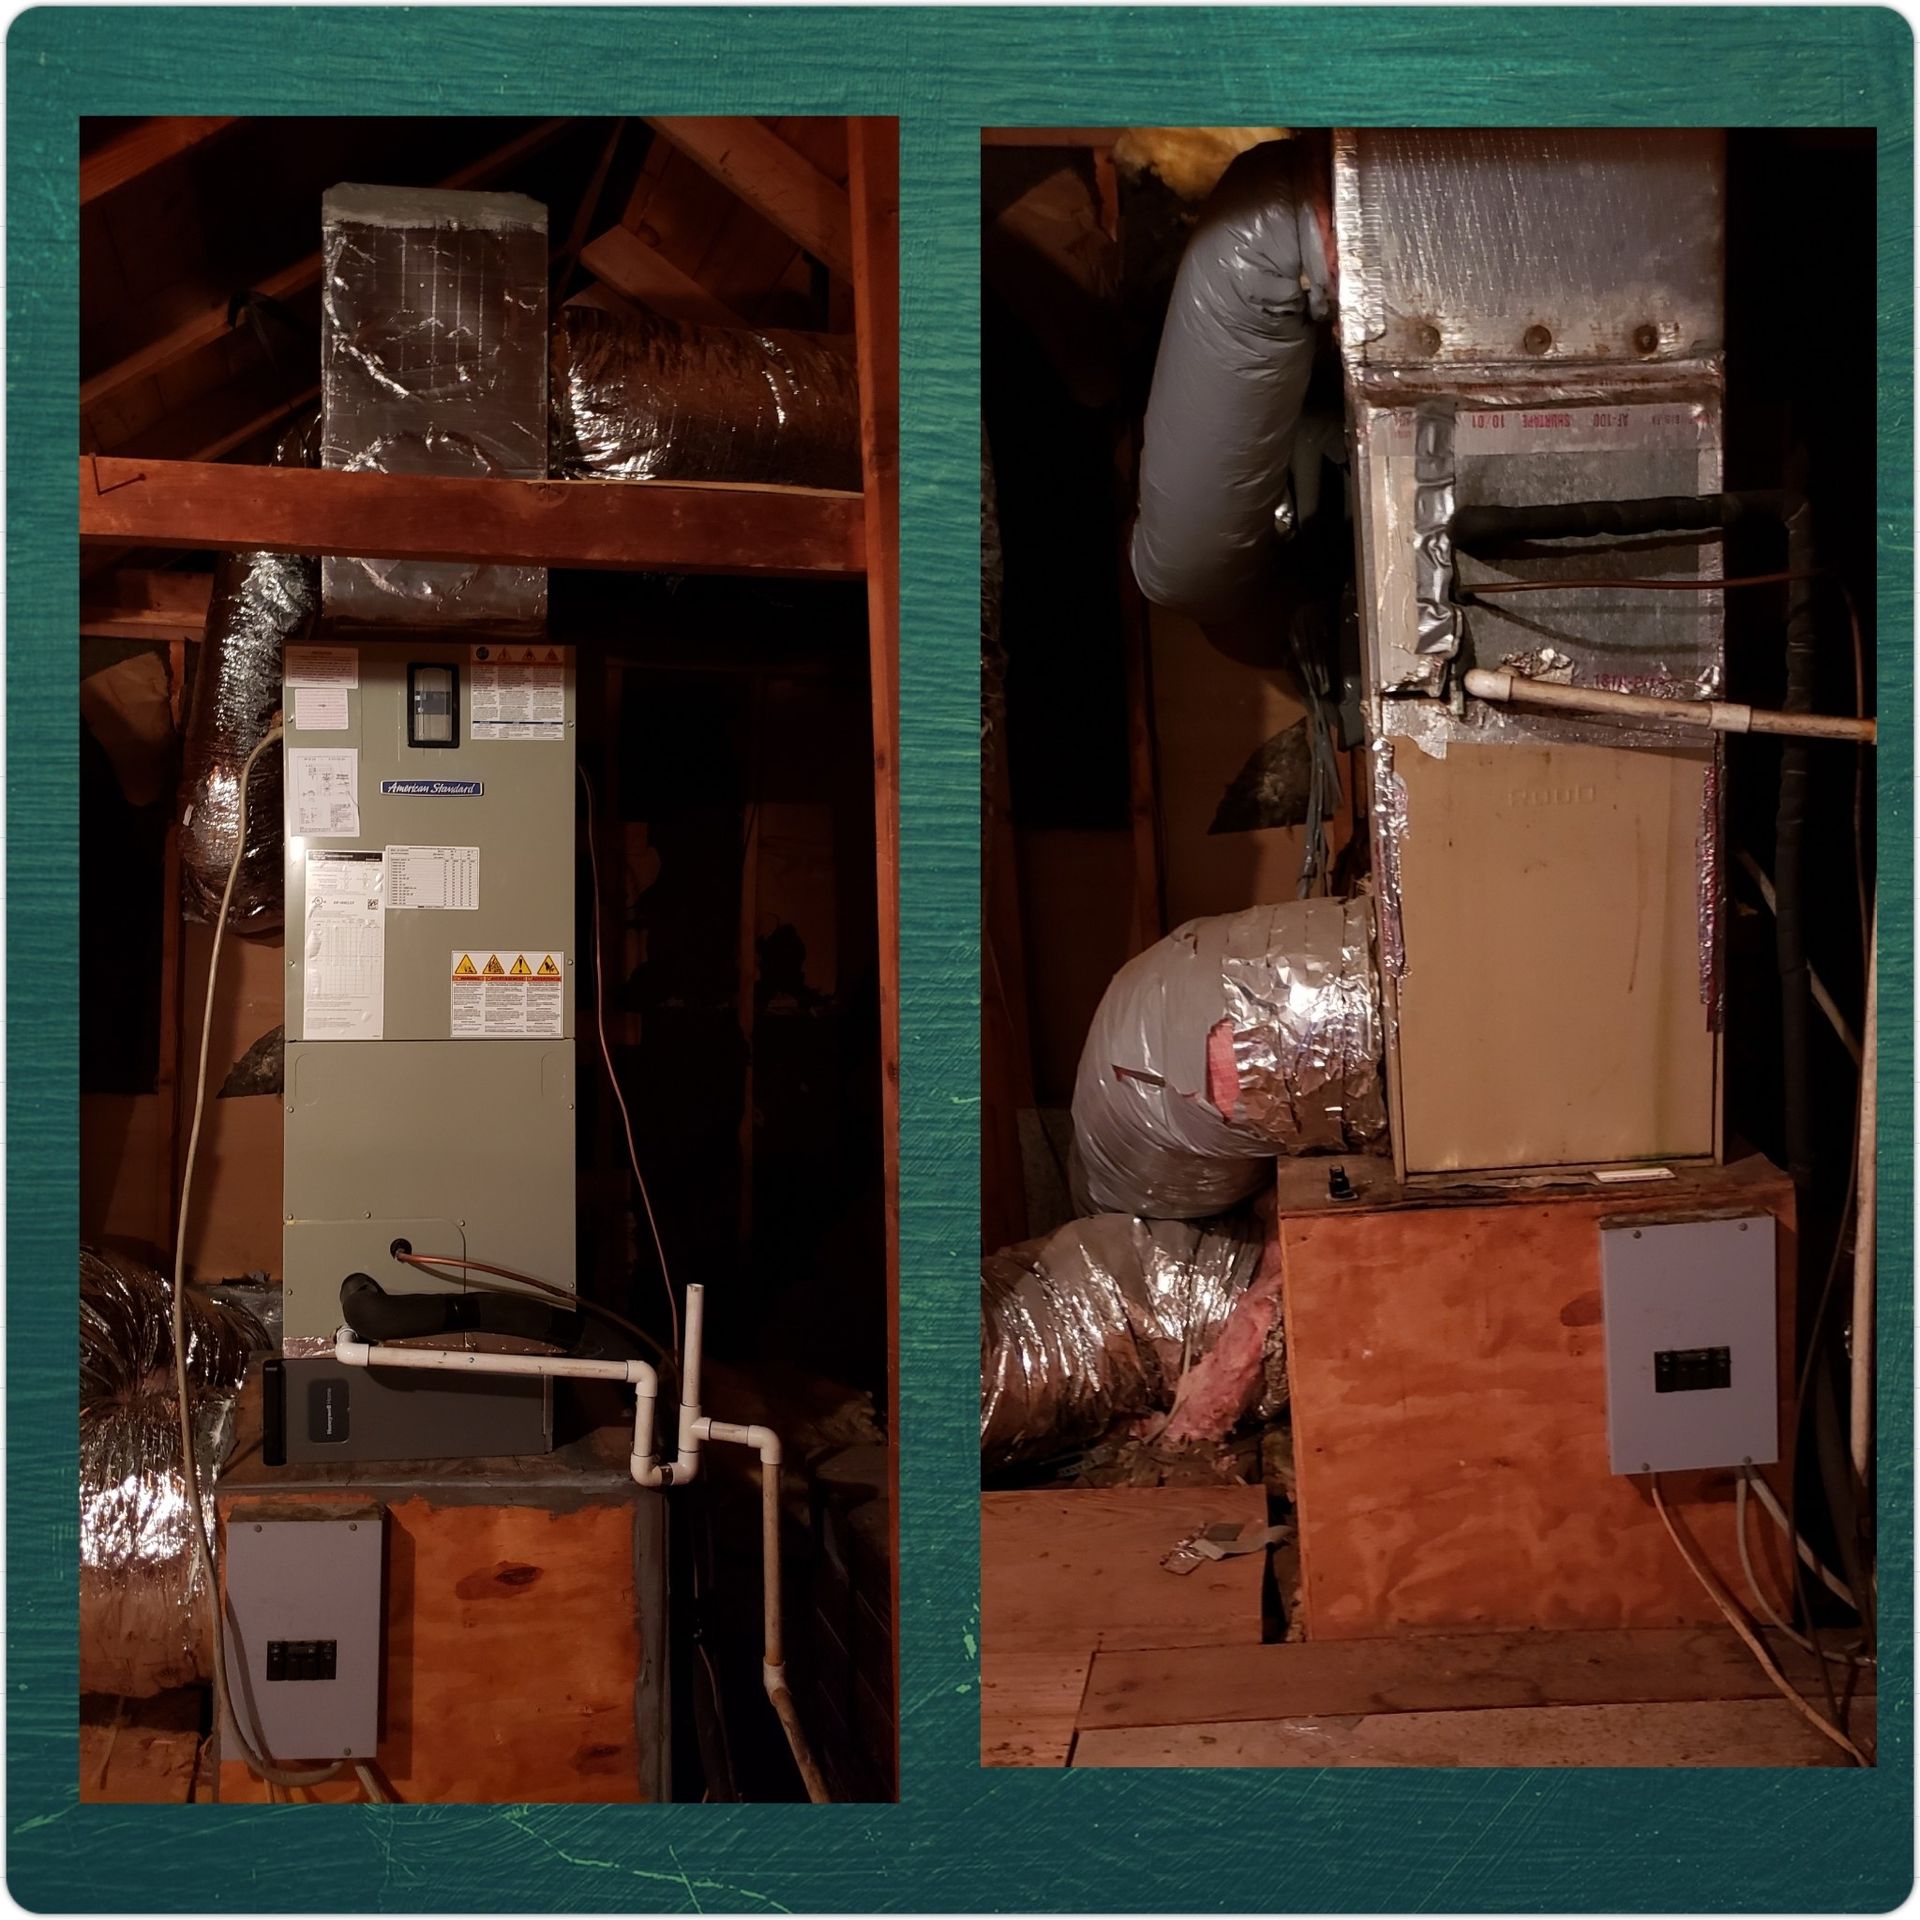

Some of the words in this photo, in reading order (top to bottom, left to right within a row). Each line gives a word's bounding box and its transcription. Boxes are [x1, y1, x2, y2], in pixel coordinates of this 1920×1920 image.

[1471, 414, 1505, 428] 10/01
[1522, 414, 1571, 428] SHURTAPE
[1593, 413, 1629, 428] AF-100
[387, 781, 430, 794] American
[430, 782, 475, 794] Standard
